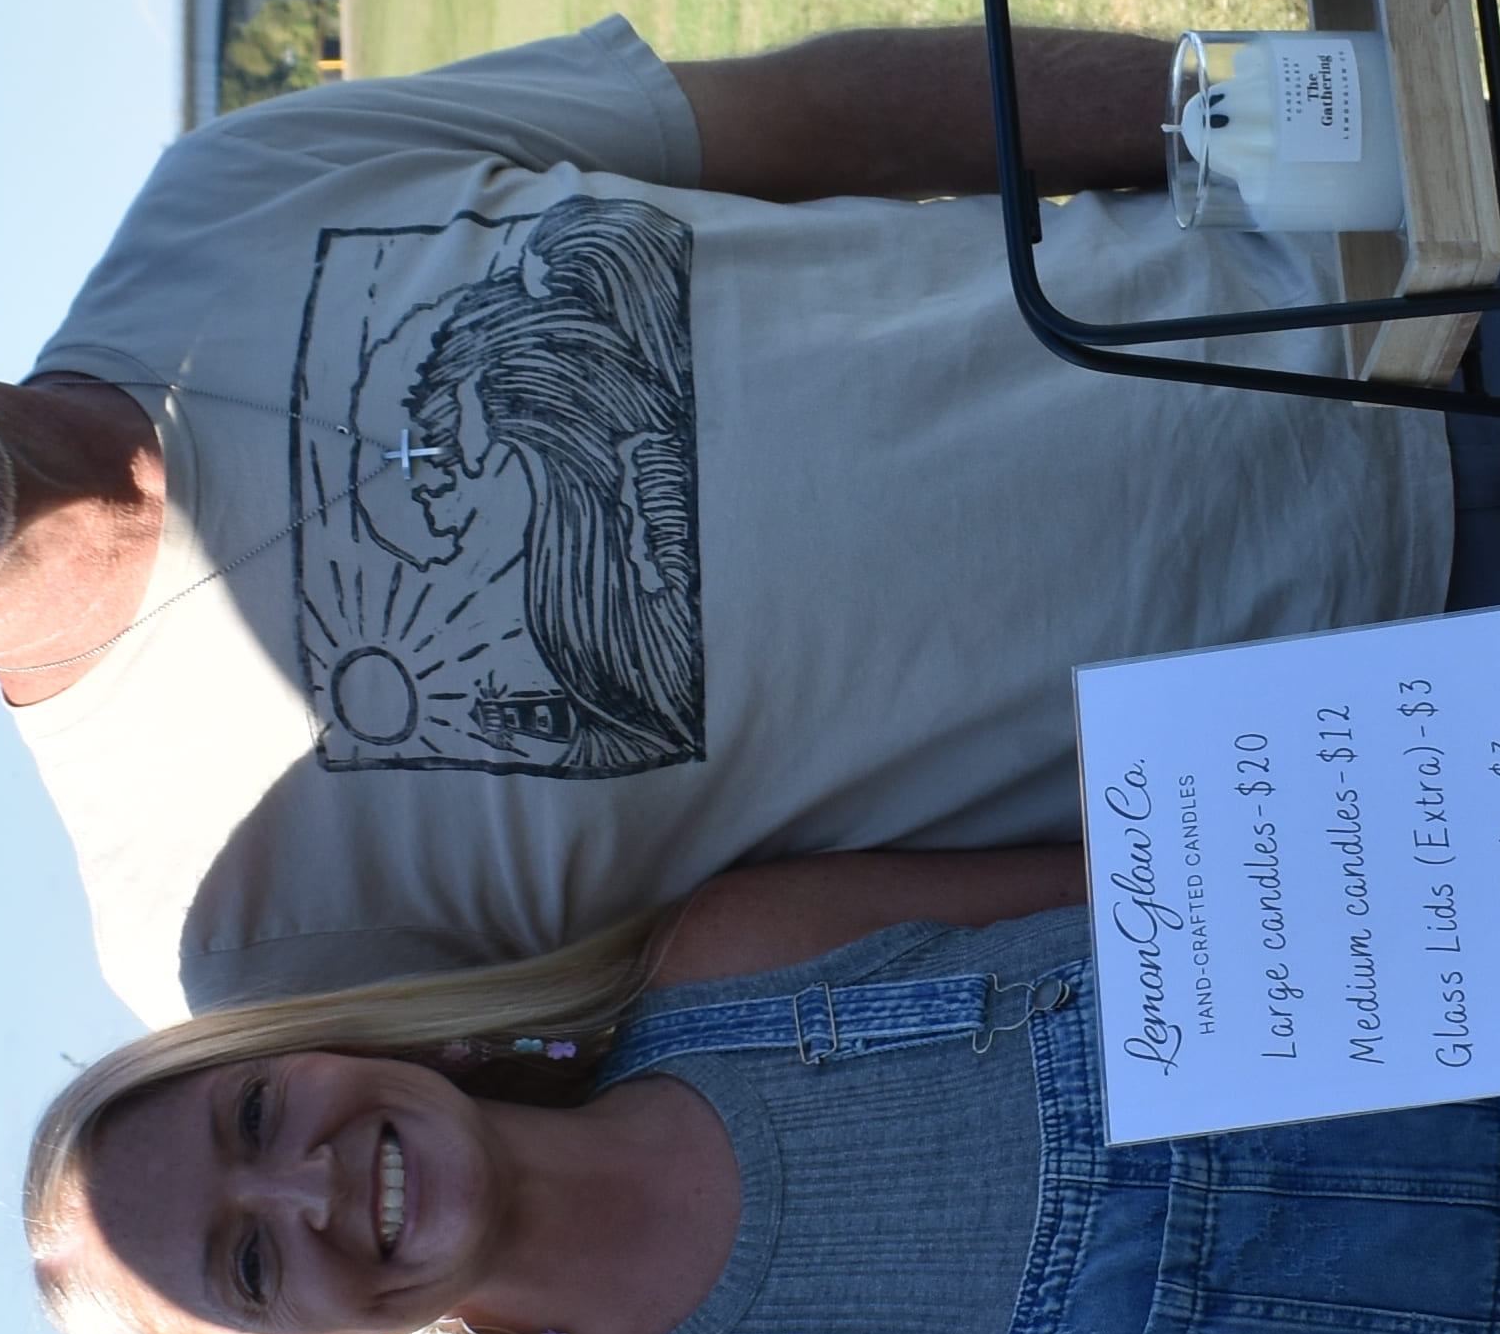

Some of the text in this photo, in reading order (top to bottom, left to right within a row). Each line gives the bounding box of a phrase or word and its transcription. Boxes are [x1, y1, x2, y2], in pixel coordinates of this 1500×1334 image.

[1306, 73, 1319, 102] The
[1316, 55, 1333, 127] Gathering
[1105, 759, 1183, 1076] LemonGlow Co.
[1179, 774, 1215, 1034] HAND-CRAFTED CANDLES
[1423, 884, 1461, 952] Lids
[1261, 963, 1304, 1058] Large
[1346, 929, 1385, 1064] Medium
[1433, 971, 1473, 1067] Glass
